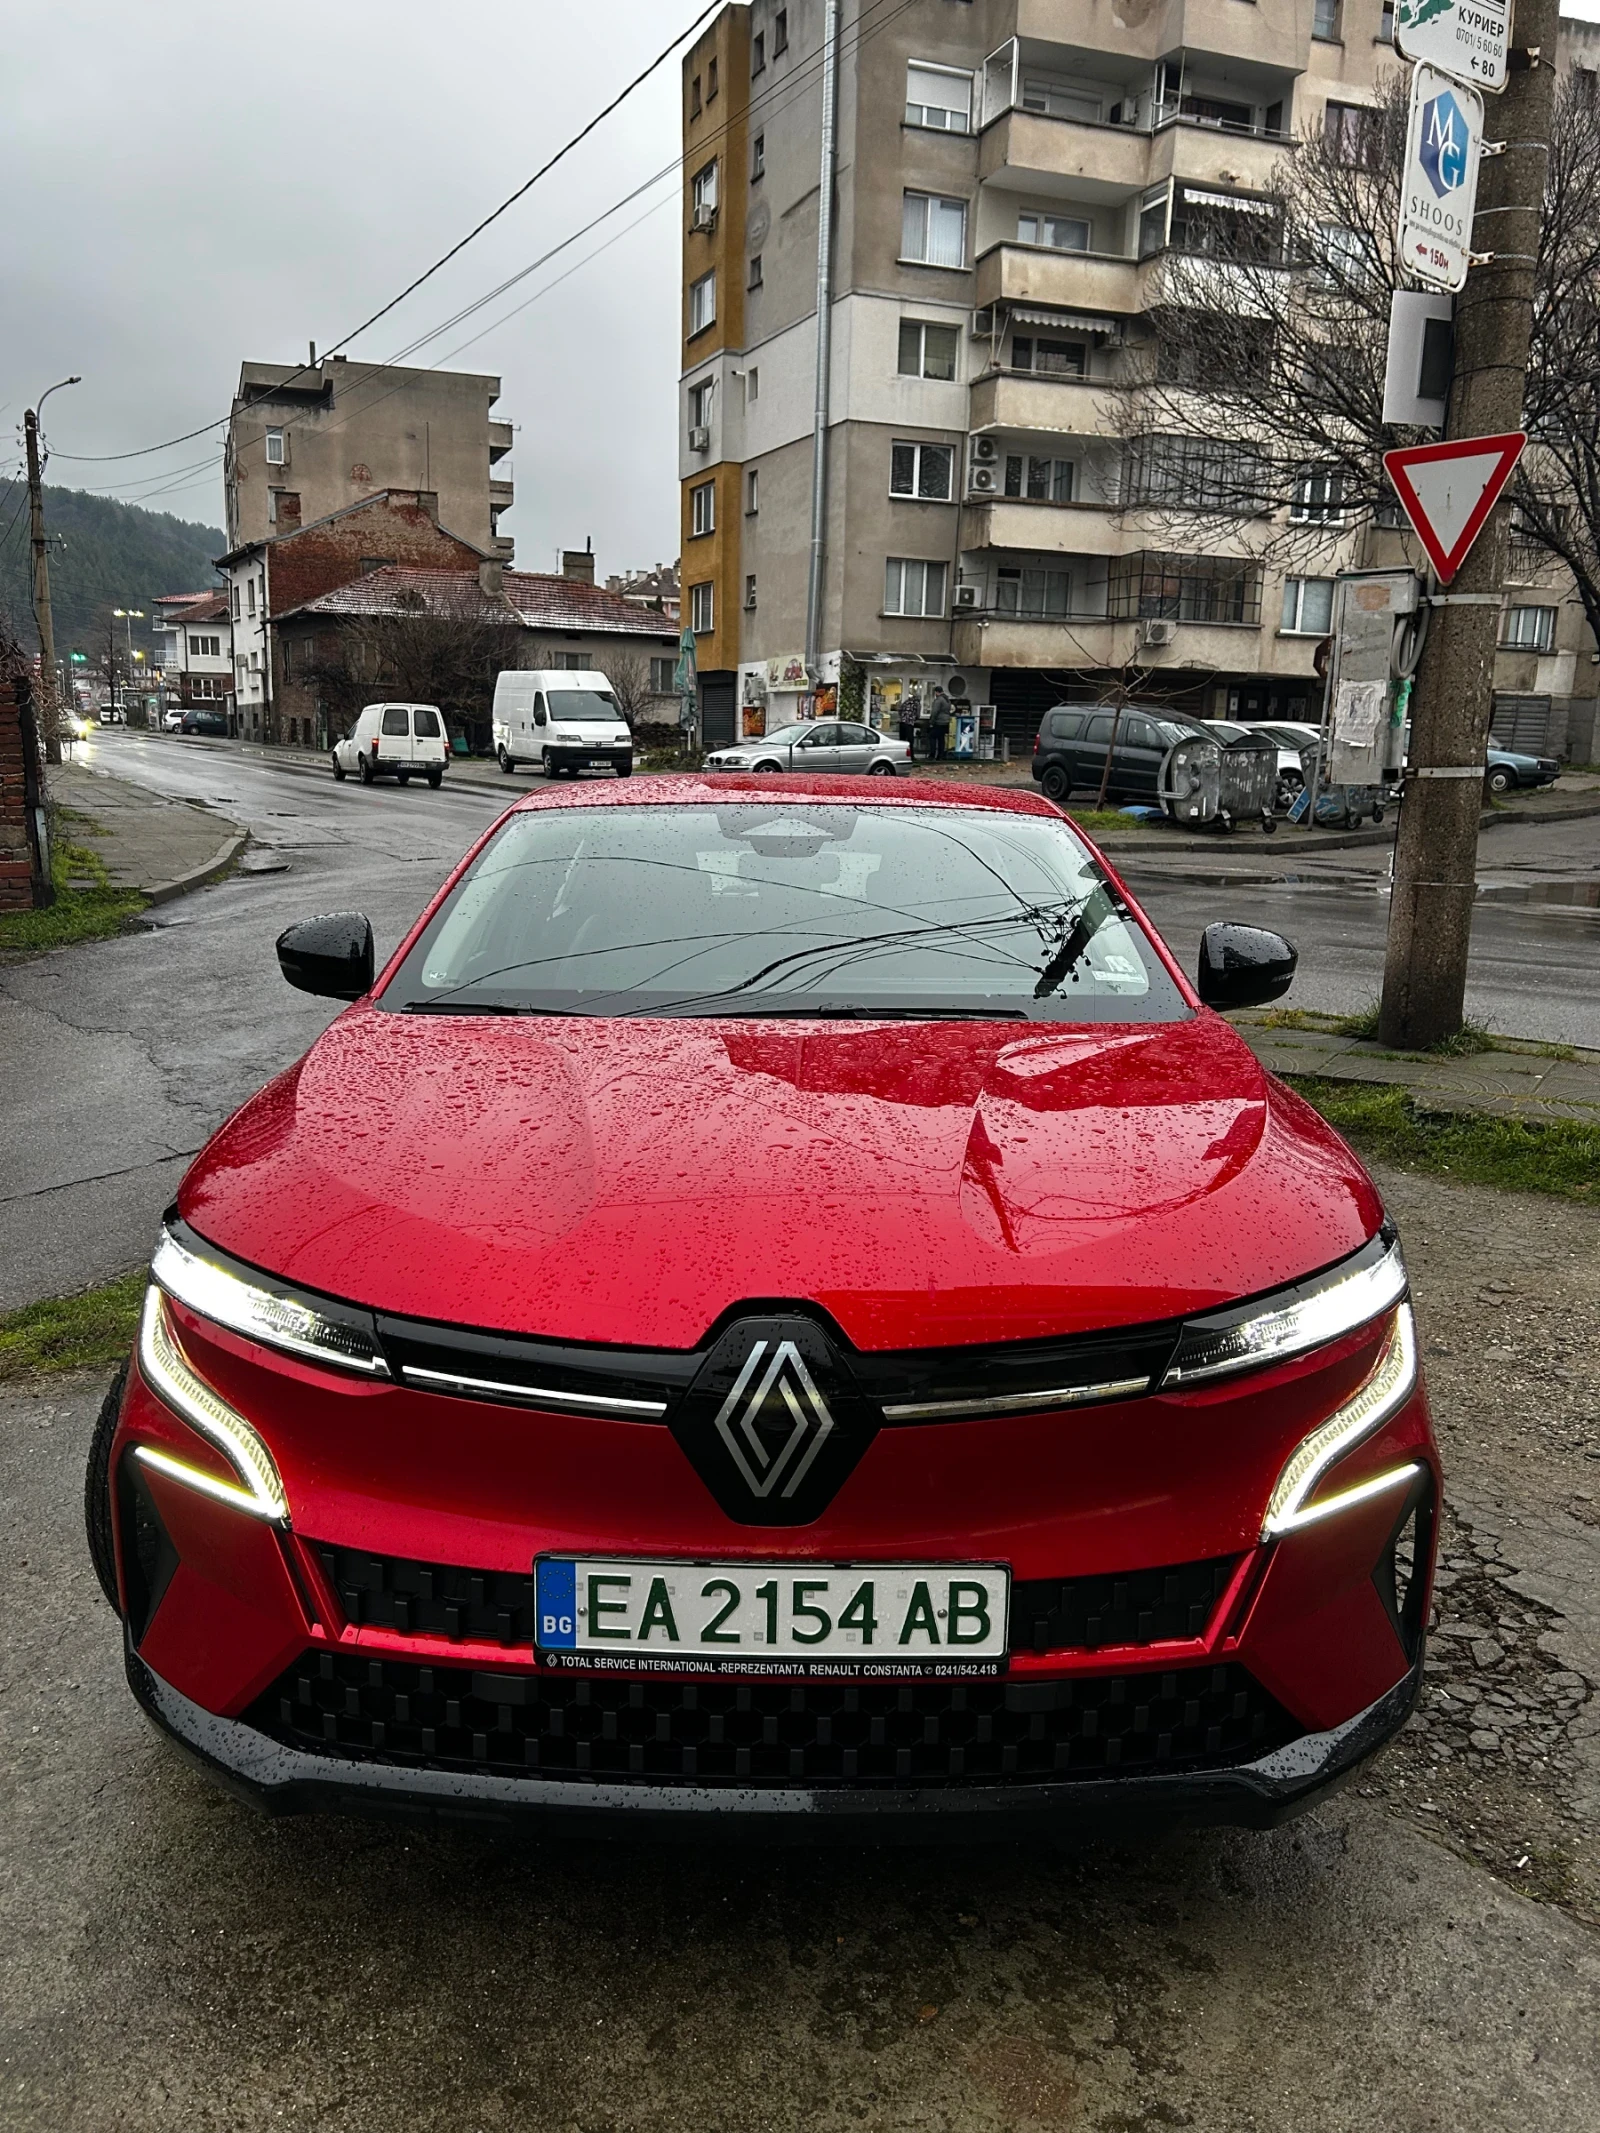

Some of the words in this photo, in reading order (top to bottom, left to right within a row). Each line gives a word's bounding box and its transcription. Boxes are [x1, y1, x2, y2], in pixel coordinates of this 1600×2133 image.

[1458, 6, 1504, 38] КУРИЕР
[1456, 27, 1476, 48] 0701/
[1482, 60, 1495, 78] 80
[1410, 196, 1463, 237] SHOOS
[587, 1574, 681, 1642] EA
[699, 1578, 878, 1645] 2154
[898, 1580, 991, 1645] AB
[543, 1614, 573, 1634] BG
[560, 1656, 592, 1668] TOTAL
[594, 1657, 636, 1670] SERVICE
[638, 1660, 717, 1673] INTERNATIONAL
[809, 1664, 861, 1676] RENAULT
[863, 1664, 923, 1676] CONSTANTA
[935, 1664, 998, 1676] 0241/542.418
